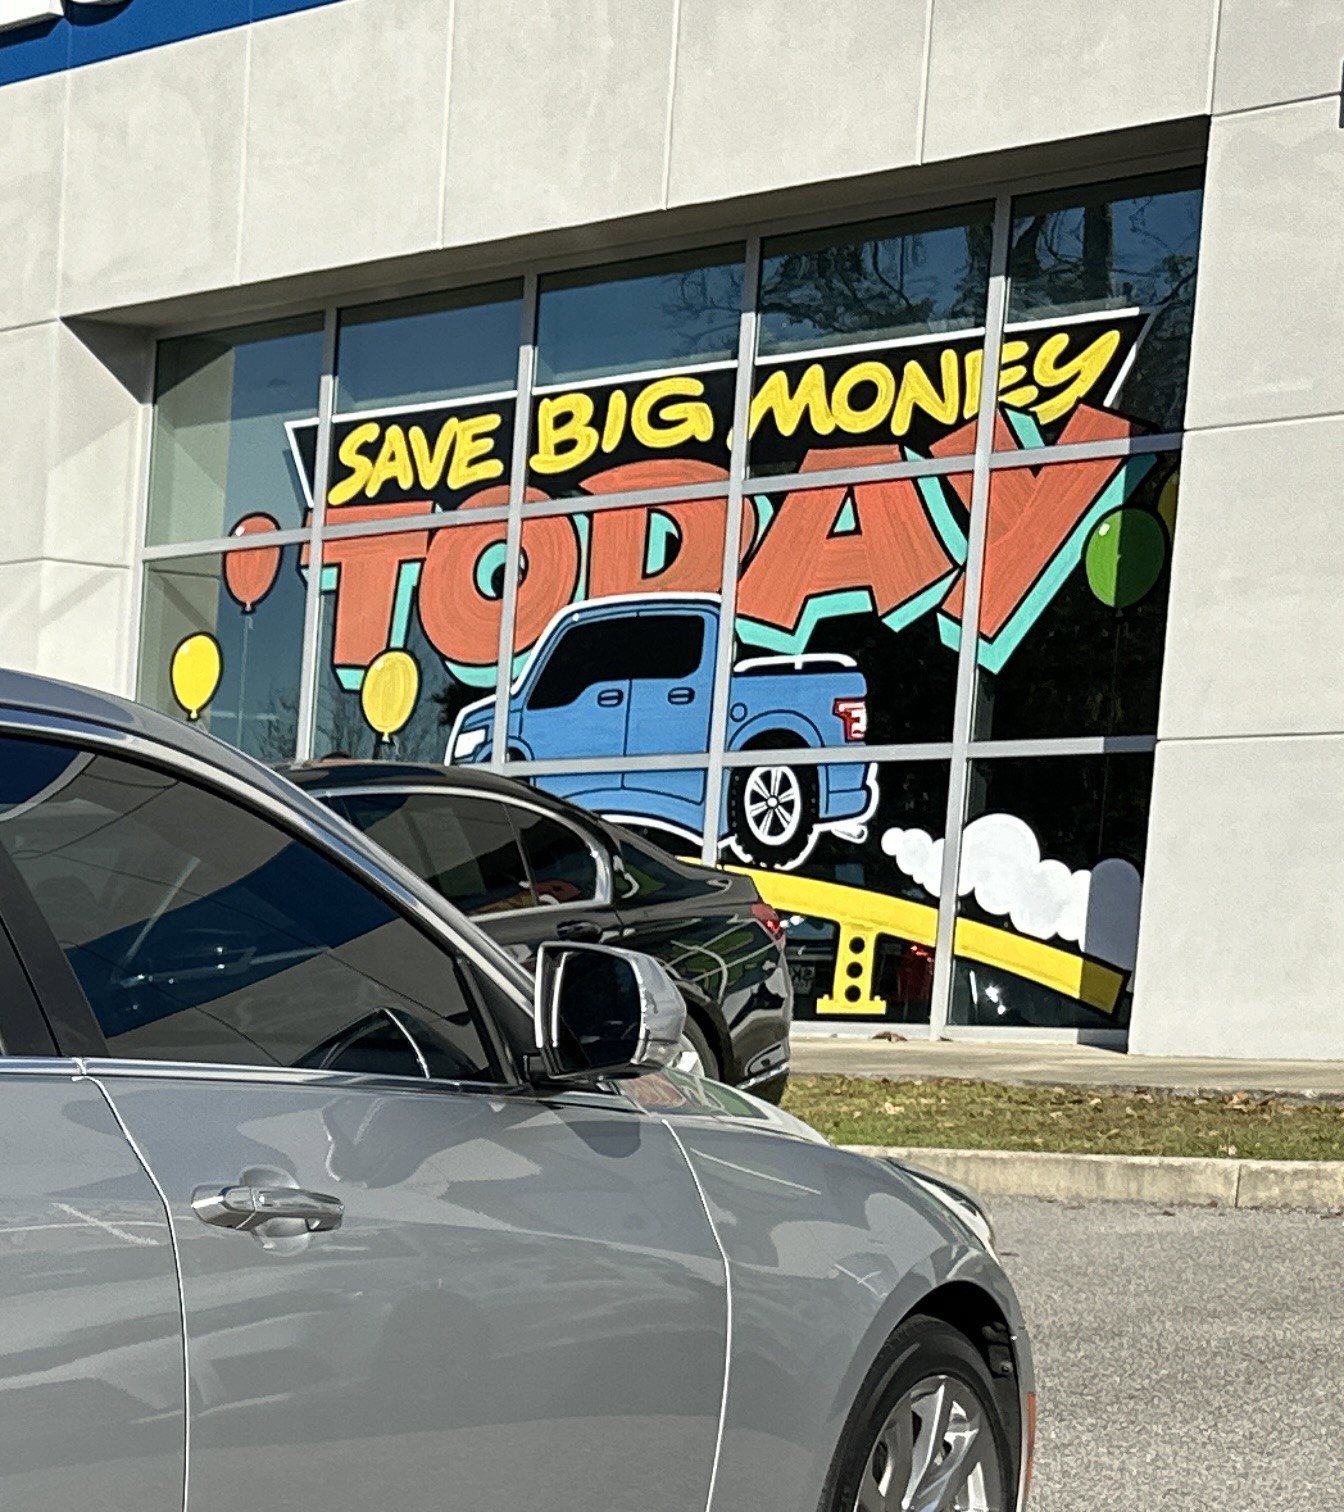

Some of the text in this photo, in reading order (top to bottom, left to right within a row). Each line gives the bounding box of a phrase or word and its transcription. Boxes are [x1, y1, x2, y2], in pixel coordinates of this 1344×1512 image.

[327, 330, 1122, 506] SAVE BIG MONEY
[299, 402, 1138, 670] TODAY
